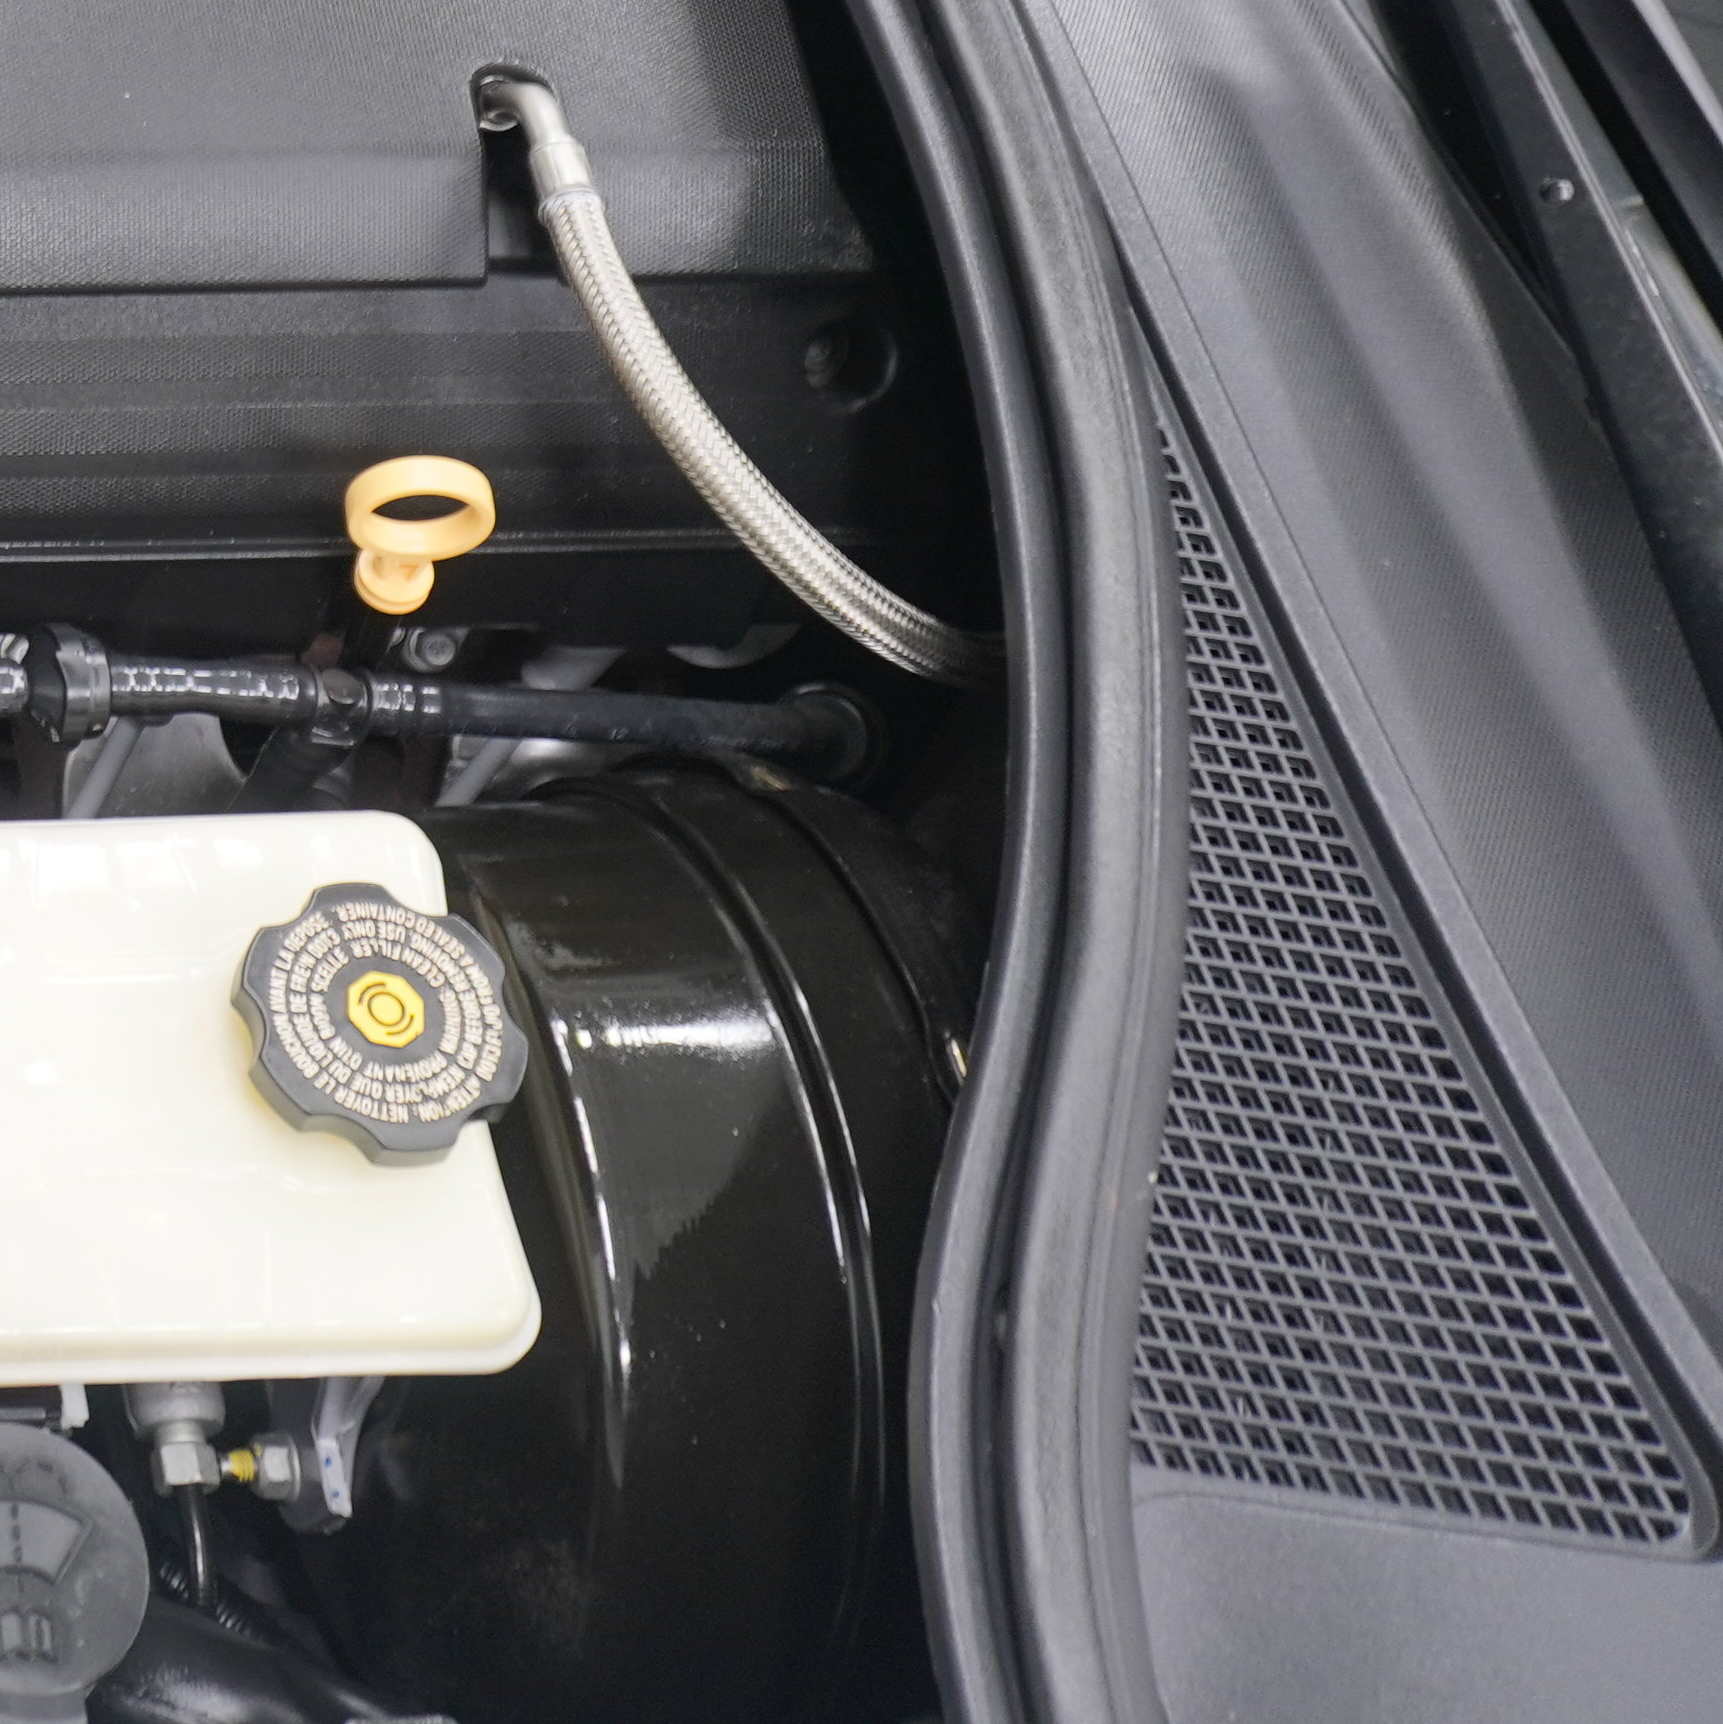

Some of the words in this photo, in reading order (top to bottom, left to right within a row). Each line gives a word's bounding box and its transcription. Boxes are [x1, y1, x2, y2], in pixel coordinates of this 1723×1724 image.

[339, 920, 376, 940] ONLY
[377, 921, 406, 944] USE
[415, 916, 468, 959] SEALED
[274, 946, 295, 971] LA
[347, 938, 402, 960] FILLER
[401, 946, 445, 987] CLEAN
[289, 951, 316, 993] FREIN
[269, 967, 288, 1013] AVANT
[289, 991, 308, 1013] DE
[458, 990, 483, 1045] BEFORE
[272, 1014, 319, 1078] BOUCHON
[292, 1014, 333, 1067] LIQUIDE
[312, 1071, 336, 1096] LE
[325, 1059, 352, 1084] DU
[364, 1050, 449, 1085] PROVENANT
[349, 1072, 383, 1101] QUE
[332, 1085, 409, 1124] NETTOYER
